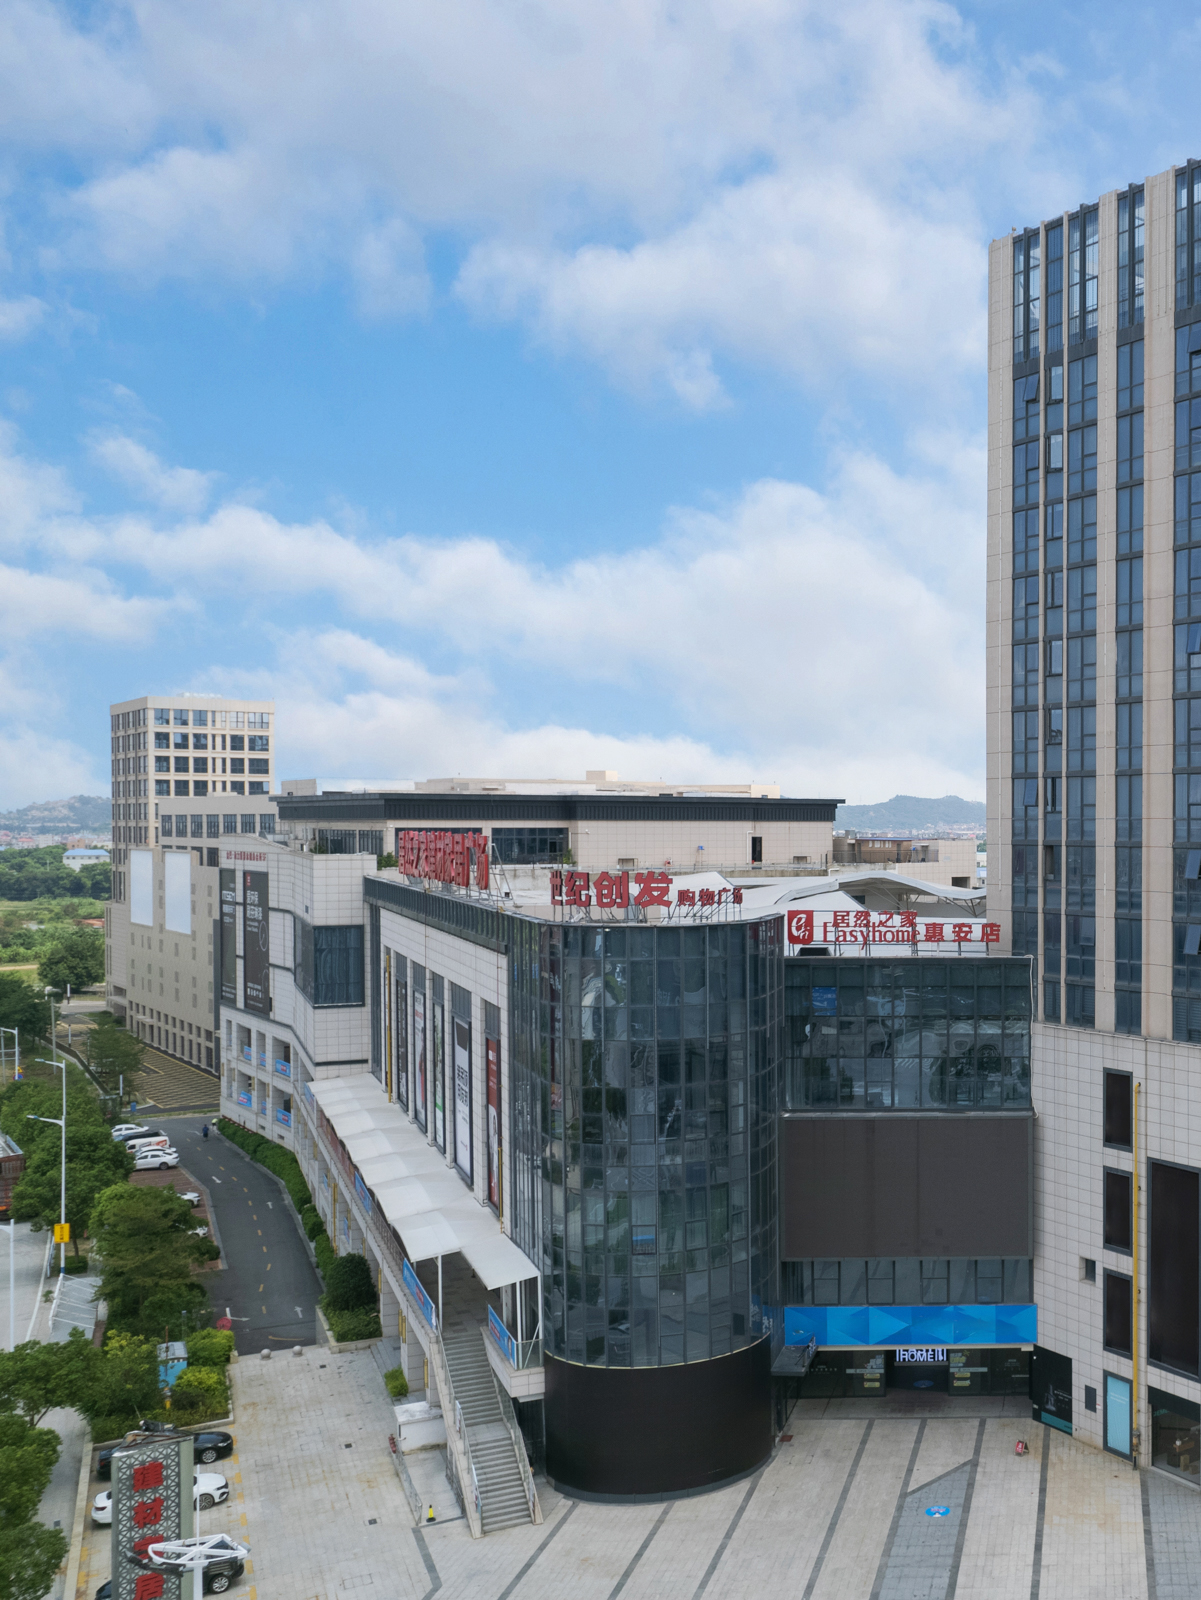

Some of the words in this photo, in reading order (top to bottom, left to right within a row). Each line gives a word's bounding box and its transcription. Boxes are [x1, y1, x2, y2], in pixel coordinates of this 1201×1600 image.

[550, 871, 673, 908] 世纪创发
[678, 887, 743, 907] 购物广场
[832, 910, 918, 928] 居然之家
[823, 921, 920, 950] Easyhome
[924, 922, 1001, 943] 惠安店
